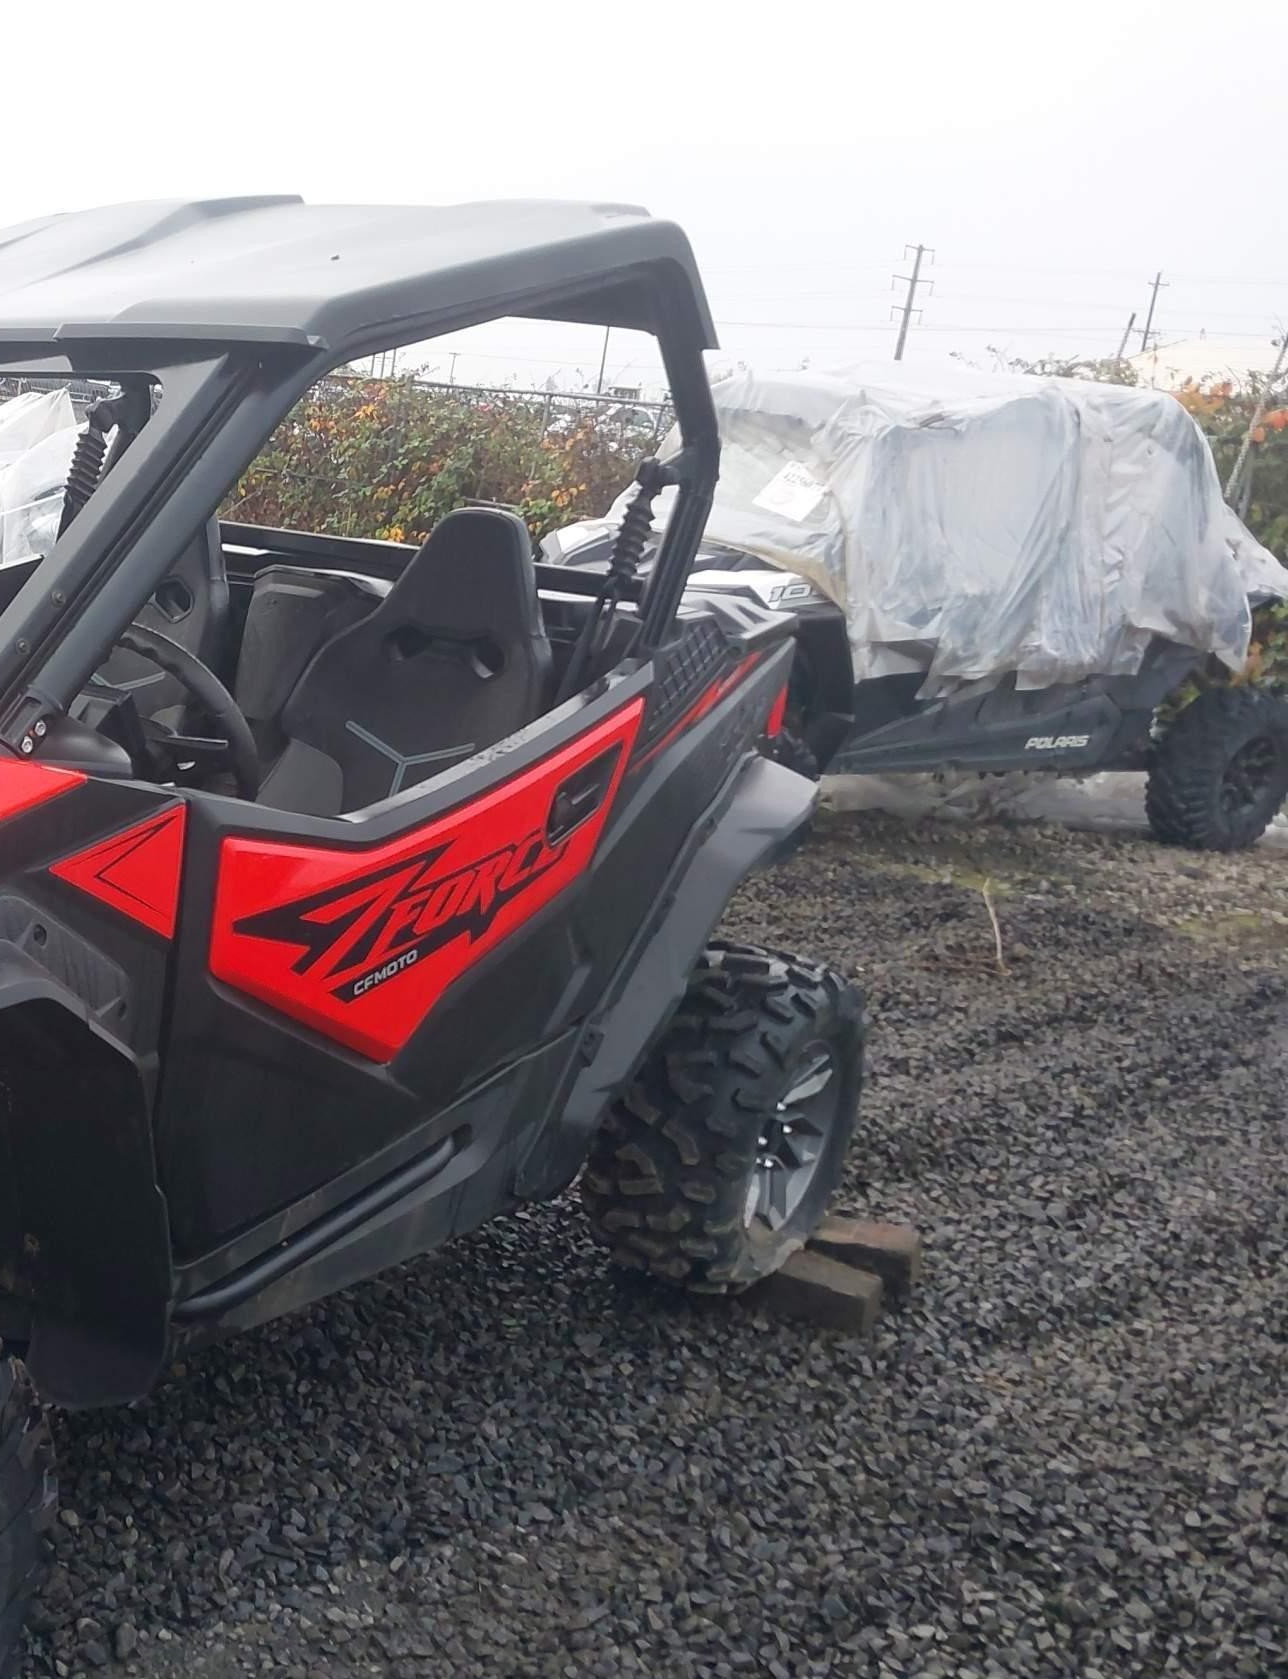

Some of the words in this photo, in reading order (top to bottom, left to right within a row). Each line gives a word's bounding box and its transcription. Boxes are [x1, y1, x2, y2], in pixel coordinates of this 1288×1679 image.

[768, 583, 818, 602] 10
[1024, 735, 1090, 750] POLARIS
[353, 949, 418, 996] CFMOTO
